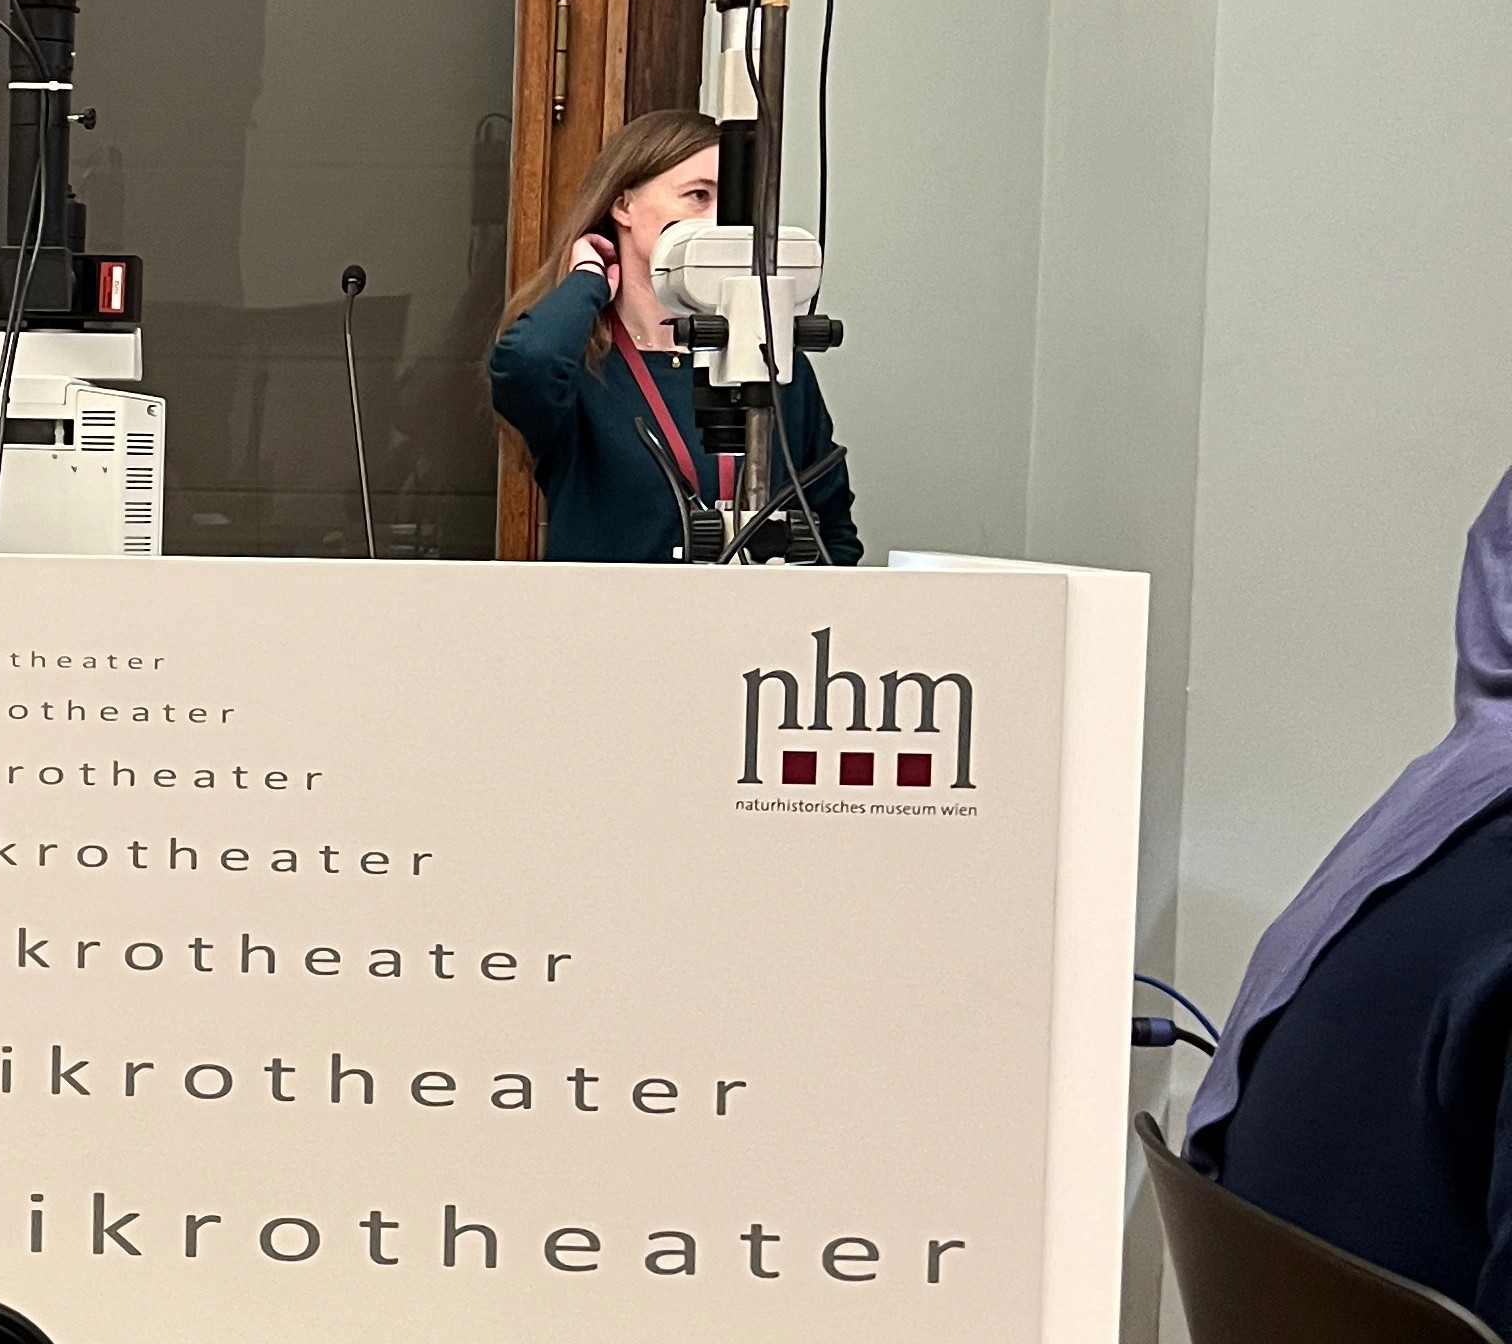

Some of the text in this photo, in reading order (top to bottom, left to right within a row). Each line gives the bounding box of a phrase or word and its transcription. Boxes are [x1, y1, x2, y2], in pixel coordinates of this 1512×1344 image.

[736, 626, 977, 790] nhm
[734, 797, 979, 818] naturhistorisches museum wien
